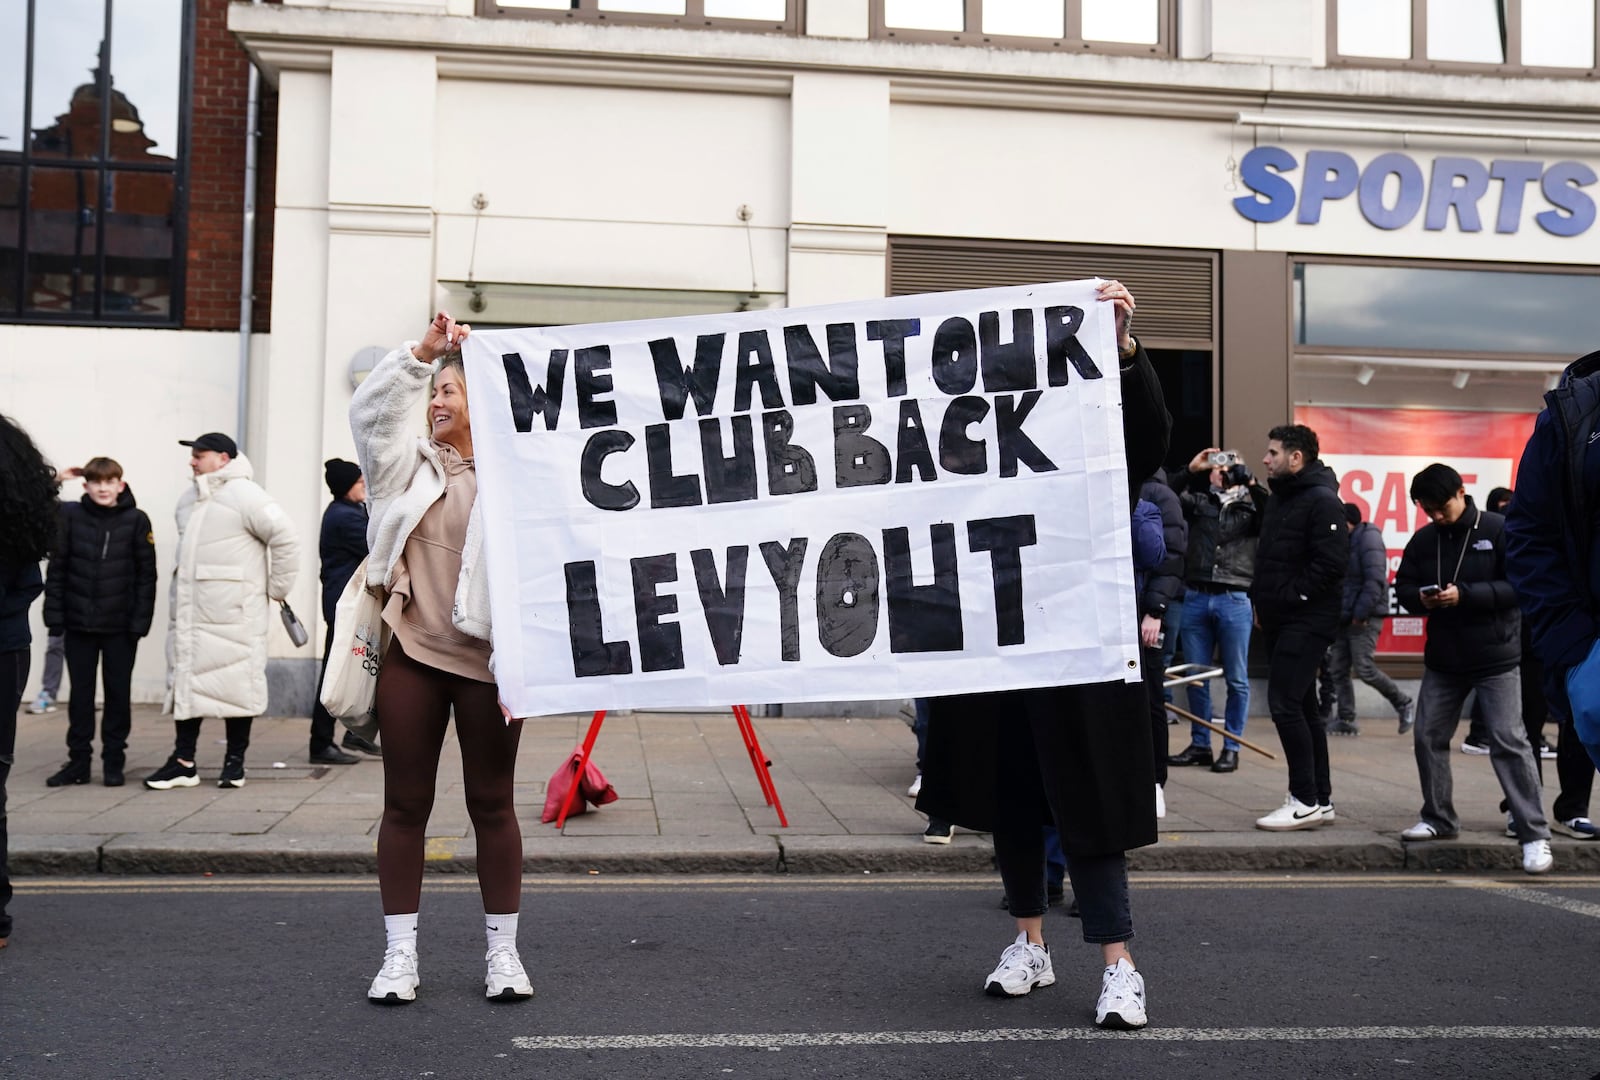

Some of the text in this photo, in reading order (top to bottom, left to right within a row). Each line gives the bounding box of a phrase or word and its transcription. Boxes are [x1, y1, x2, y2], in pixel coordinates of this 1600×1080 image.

[1233, 146, 1599, 237] SPORTS
[501, 305, 1103, 433] WE WANT OUR
[580, 390, 1059, 511] CLUB BACK
